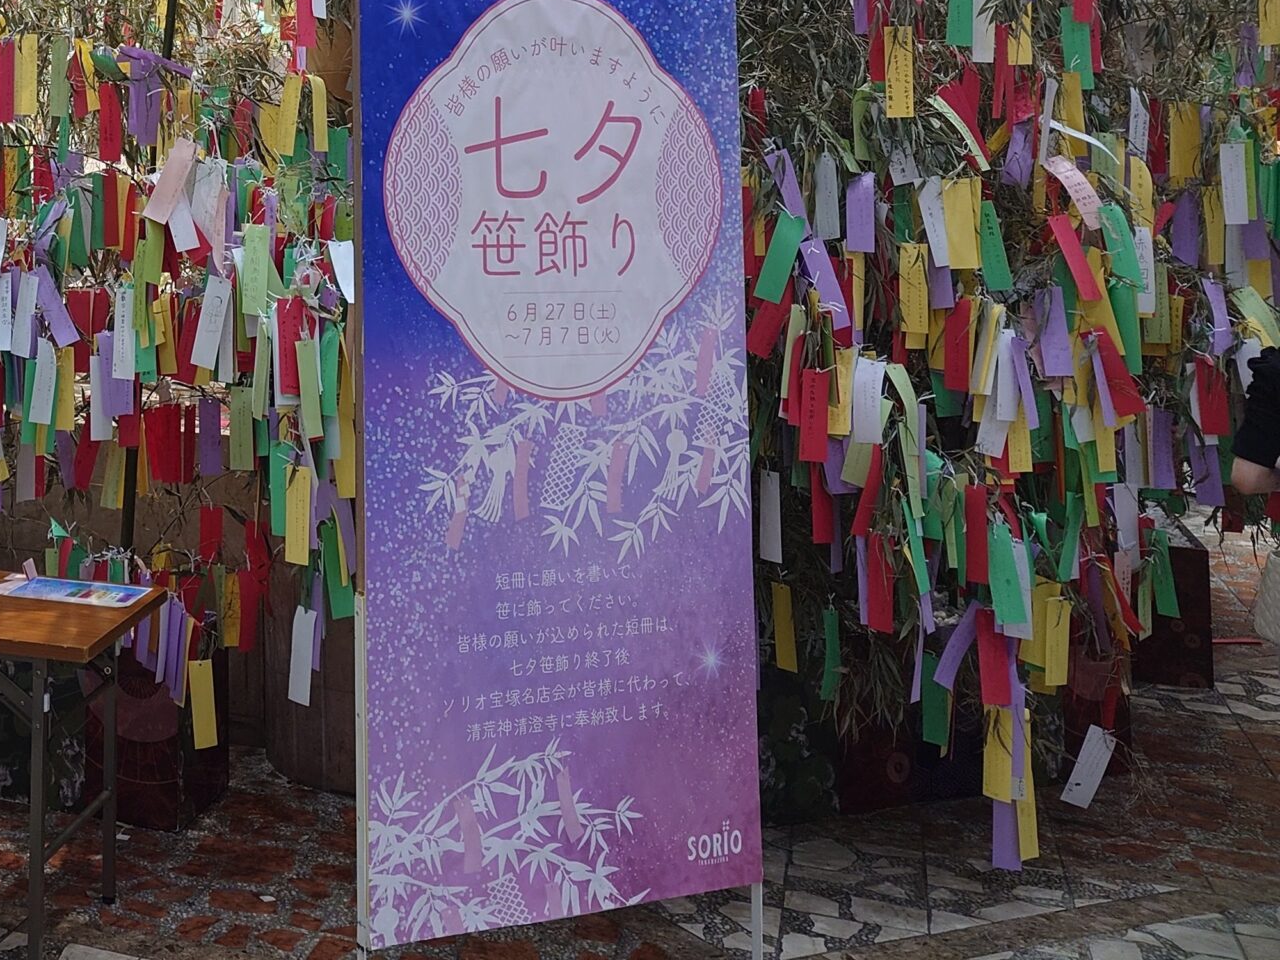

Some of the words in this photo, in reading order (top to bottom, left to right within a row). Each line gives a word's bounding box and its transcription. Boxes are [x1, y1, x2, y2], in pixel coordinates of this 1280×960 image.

[446, 35, 666, 123] 皆様の願いが叶いますように
[464, 96, 643, 205] 七夕
[471, 209, 637, 277] 笹飾り
[494, 564, 638, 591] 短冊に願いを書いて、
[495, 593, 640, 620] 笹に飾ってください。
[456, 616, 676, 654] 皆様の願いが込められた短冊は、
[509, 647, 631, 677] 七夕笹飾り終了後
[443, 671, 692, 714] ソリオ宝塚名店会が皆様に代わって、
[466, 701, 671, 742] 清荒神清澄寺に奉納致します。
